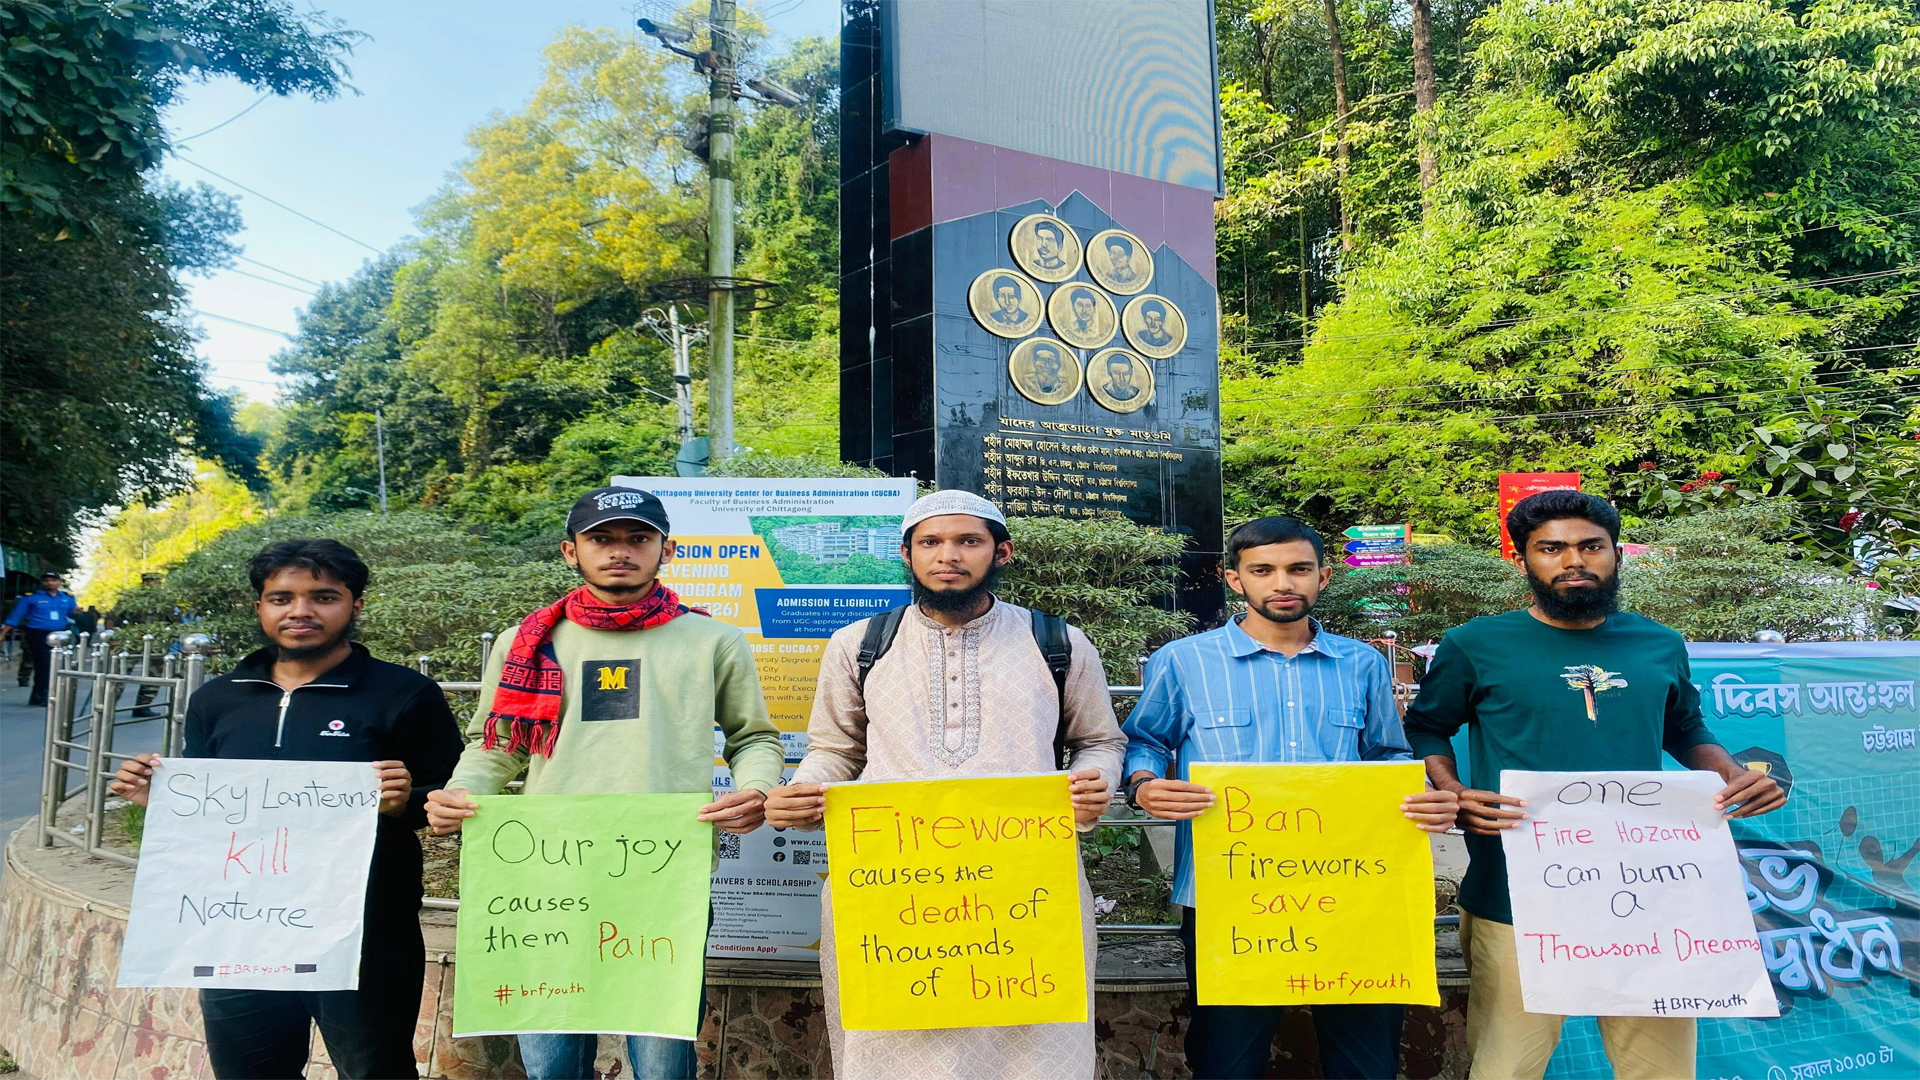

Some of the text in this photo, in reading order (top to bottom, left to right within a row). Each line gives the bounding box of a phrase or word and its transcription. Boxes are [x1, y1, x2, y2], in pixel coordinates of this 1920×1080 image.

[651, 489, 901, 498] Chittagong University Center for Business Administration (CUCBA)
[690, 498, 721, 506] Faculty
[766, 505, 812, 513] Chittagong
[718, 545, 760, 559] OPEN
[659, 563, 730, 578] EVENING
[776, 598, 891, 608] ADMISSION ELIGIBILITY
[847, 610, 879, 618] disciplin
[778, 644, 820, 654] CUCBA?
[781, 656, 811, 664] Degree
[597, 666, 630, 690] M
[763, 665, 779, 673] City
[1711, 672, 1800, 717] দিবস
[1862, 724, 1916, 751] চট্টগ্রাম
[167, 772, 379, 825] Sky Lanterns
[1224, 786, 1323, 835] Ban
[492, 820, 682, 878] Our joy
[1532, 821, 1595, 853] Fire
[1221, 841, 1387, 880] fireworks
[747, 878, 753, 886] &
[849, 864, 994, 888] causes the
[1619, 861, 1703, 885] burn
[178, 891, 314, 929] Nature
[487, 896, 590, 915] causes
[899, 887, 1049, 926] death of
[1250, 892, 1338, 915] save
[484, 921, 675, 964] them Pain
[756, 945, 778, 953] Apply
[860, 927, 1015, 964] thousands
[1231, 925, 1319, 956] birds
[1523, 928, 1761, 964] Thousand Dreams
[910, 957, 1056, 1000] of birds
[1286, 971, 1412, 997] #brfyouth
[1789, 1046, 1894, 1080] সকাল ১০.০০ টা
